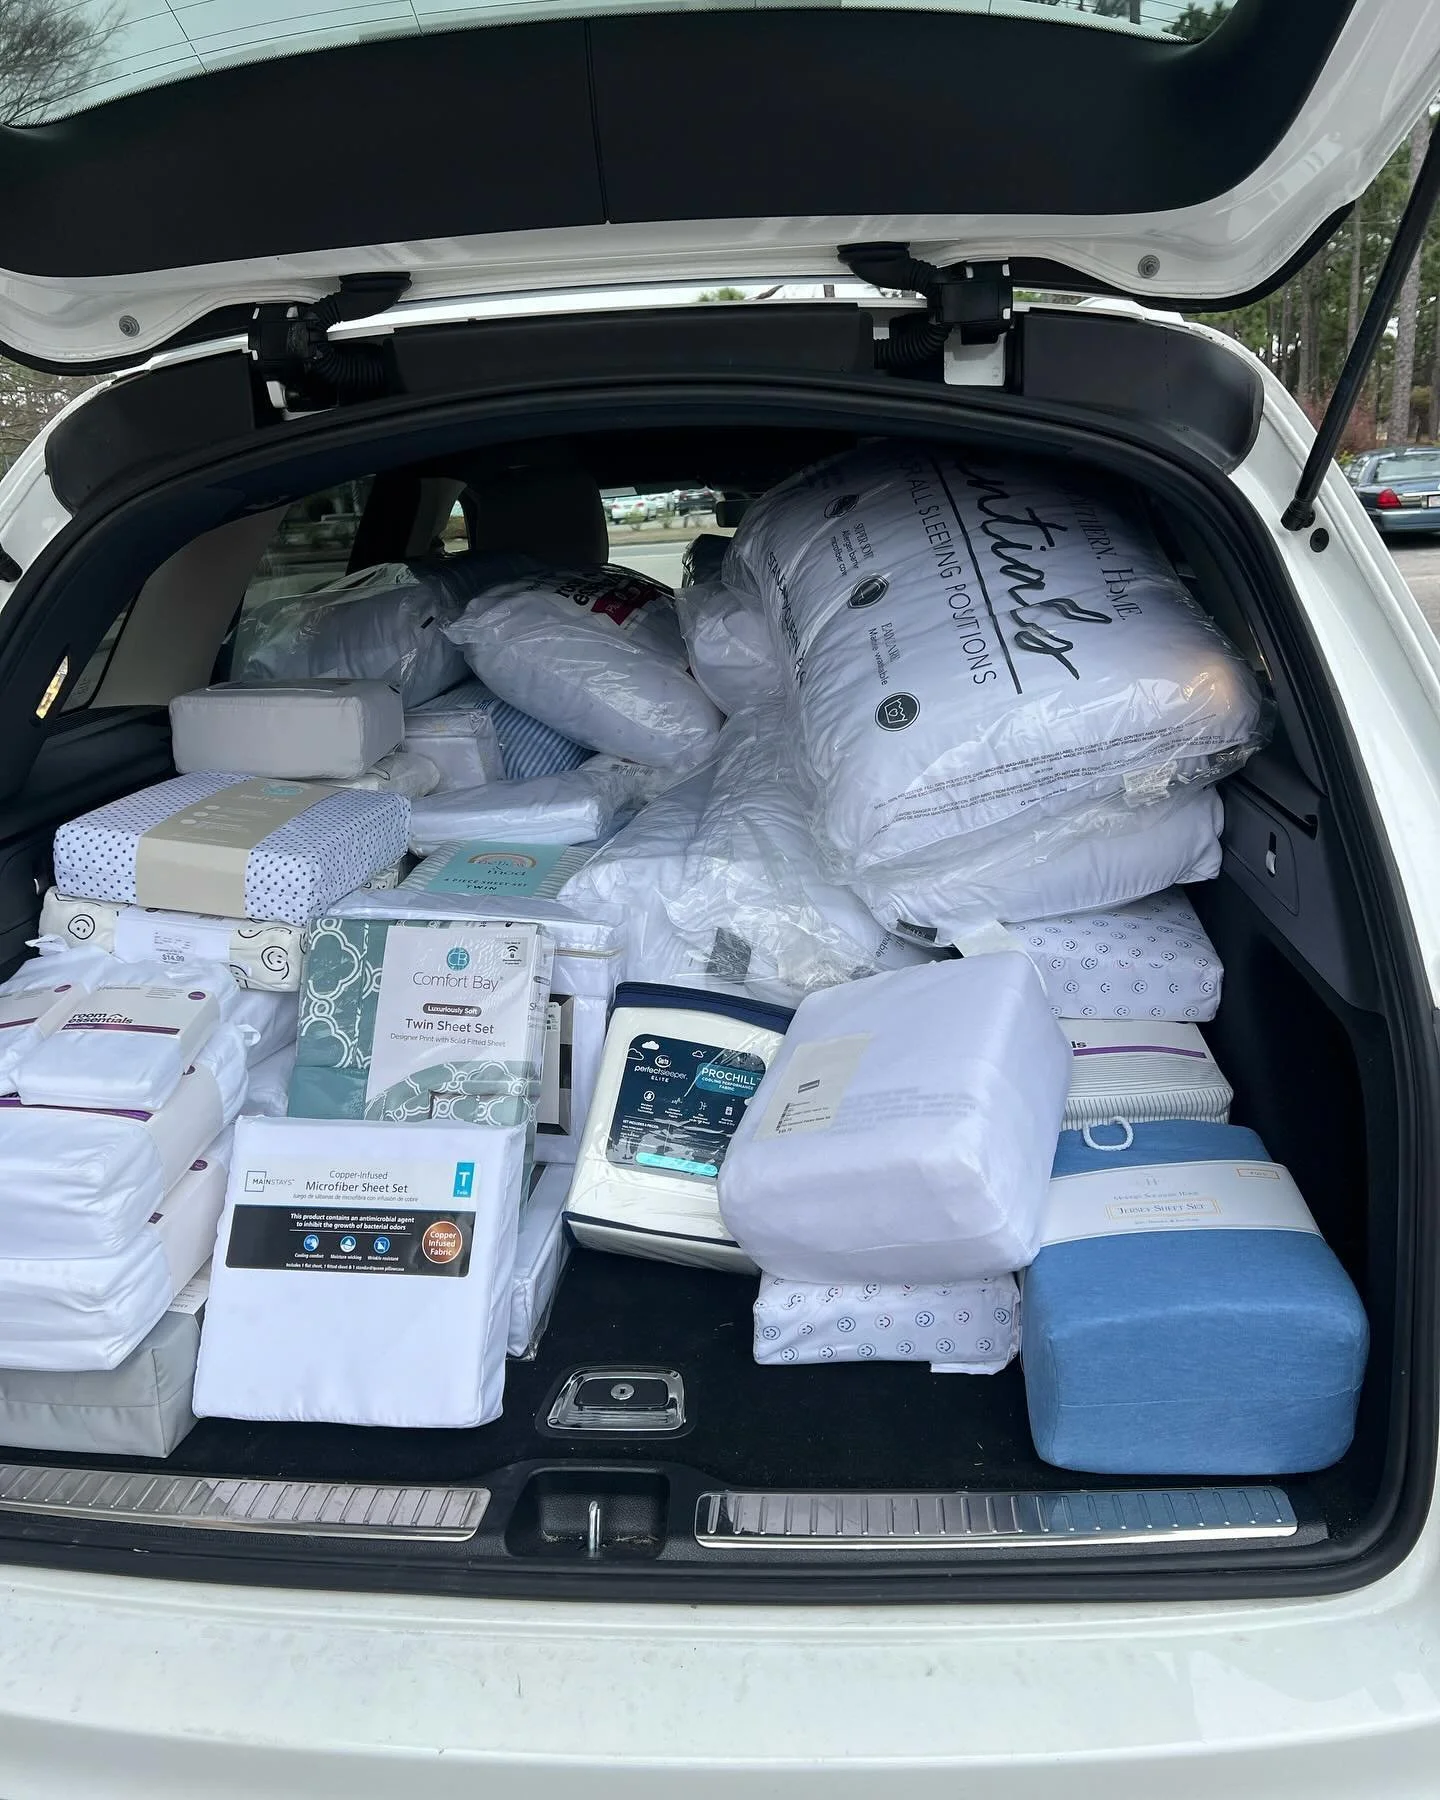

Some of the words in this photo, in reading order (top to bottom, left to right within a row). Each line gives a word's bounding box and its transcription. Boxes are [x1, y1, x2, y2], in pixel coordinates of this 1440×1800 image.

[907, 478, 935, 505] ALL
[161, 953, 185, 963] $14.99
[412, 971, 468, 989] Comfort
[472, 975, 499, 992] Bay
[427, 1004, 464, 1015] Luxuriously
[464, 1006, 478, 1015] Soft
[68, 1016, 134, 1024] essentials
[405, 1018, 434, 1030] Twin
[437, 1020, 472, 1033] Sheet
[474, 1023, 495, 1035] Set
[390, 1033, 418, 1041] Designer
[435, 1035, 449, 1043] with
[450, 1037, 466, 1045] Solid
[467, 1038, 486, 1046] Fitted
[487, 1039, 506, 1047] Sheet
[650, 1074, 670, 1083] ELITE
[701, 1067, 756, 1086] PROCHILL
[329, 1170, 389, 1180] Copper-Infused
[458, 1171, 471, 1187] T
[252, 1178, 293, 1186] MAINSTAYS
[305, 1180, 360, 1192] Microfiber
[361, 1182, 390, 1193] Sheet
[391, 1183, 408, 1193] Set
[302, 1213, 325, 1221] product
[303, 1220, 322, 1228] inhibit
[430, 1231, 457, 1240] Copper
[428, 1239, 456, 1248] Infused
[430, 1248, 453, 1256] Fabric
